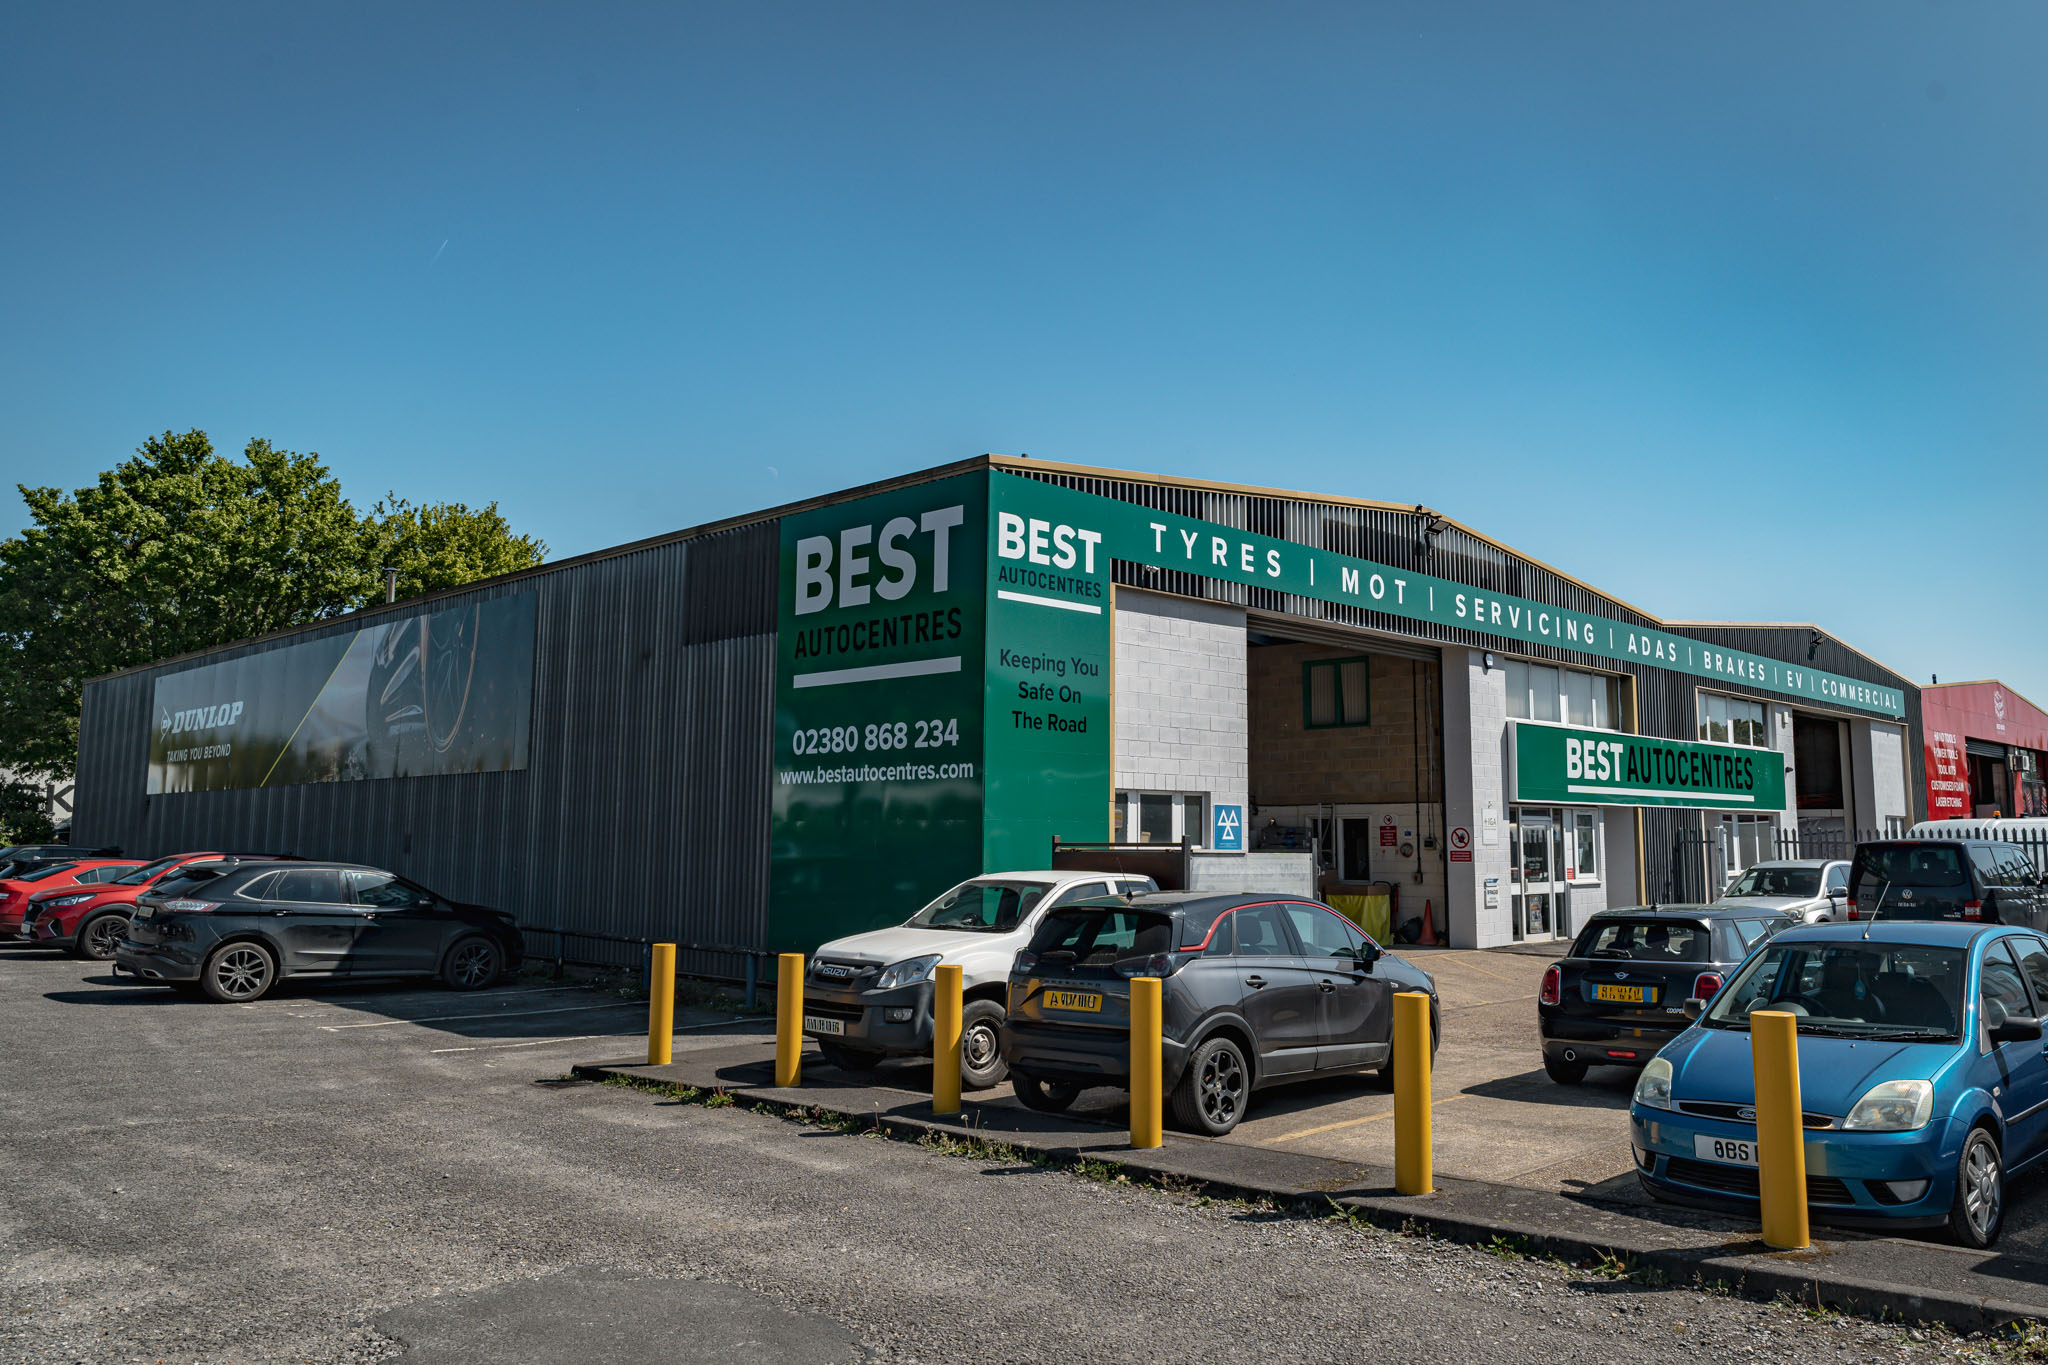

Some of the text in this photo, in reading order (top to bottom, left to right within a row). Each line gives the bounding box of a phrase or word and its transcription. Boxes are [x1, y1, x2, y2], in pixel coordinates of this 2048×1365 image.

[998, 511, 1102, 574] BEST
[795, 505, 964, 616] BEST
[998, 565, 1102, 599] AUTOCENTRES
[1150, 522, 1281, 578] TYRES
[1342, 567, 1406, 604] MOT
[1455, 593, 1594, 644] SERVICING
[1628, 633, 1677, 662] ADAS
[1704, 651, 1765, 682] BRAKES
[1787, 670, 1803, 689] EV
[1821, 677, 1897, 709] COMMERCIAL
[794, 607, 963, 660] AUTOCENTRES
[1000, 649, 1099, 678] Keeping You
[1018, 681, 1082, 704] Safe On
[171, 701, 244, 734] DUNLOP
[1012, 711, 1087, 734] The Road
[167, 744, 231, 763] TAKING YOU BEYOND
[793, 719, 959, 756] 02380 868 234
[780, 762, 974, 785] www.bestautocentres.com
[1566, 737, 1754, 791] BEST AUTOCENTRES
[823, 967, 848, 977] ISUZU
